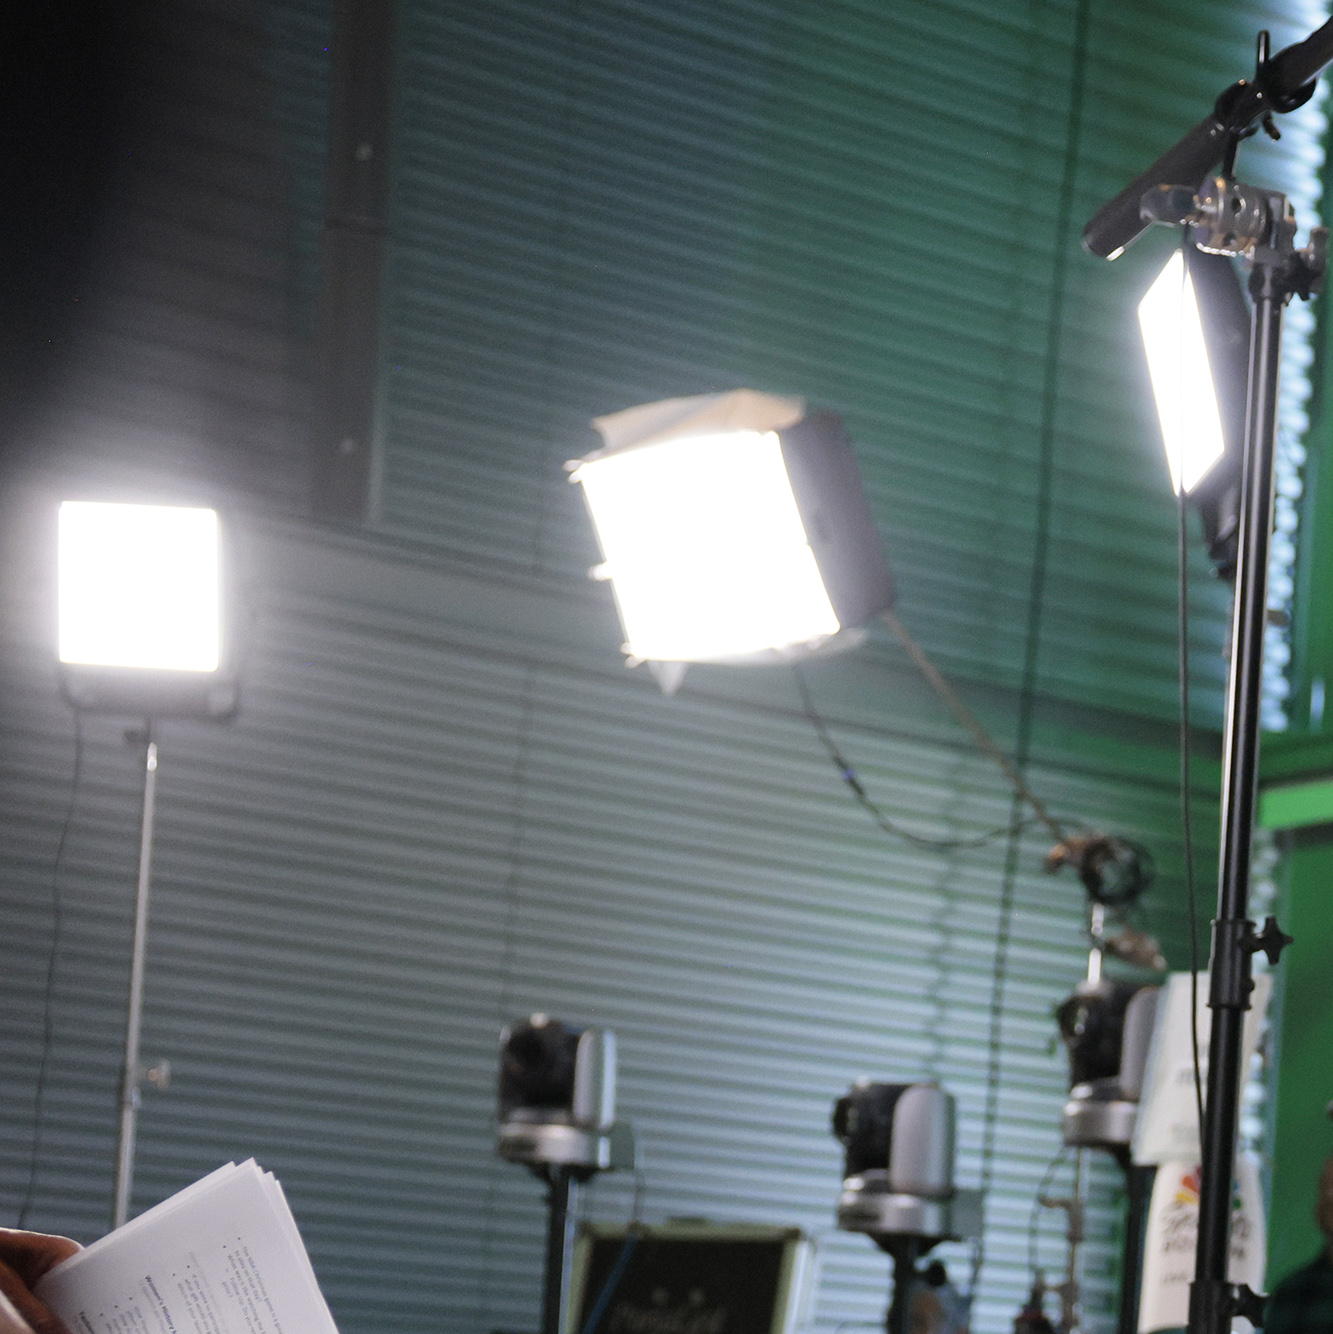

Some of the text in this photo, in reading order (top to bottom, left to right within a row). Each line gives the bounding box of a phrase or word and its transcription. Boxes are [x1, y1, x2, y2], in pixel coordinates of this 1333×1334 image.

[227, 1252, 238, 1270] What
[234, 1269, 242, 1281] was
[236, 1256, 246, 1269] play
[246, 1276, 256, 1289] that
[251, 1288, 261, 1303] day?
[242, 1245, 251, 1257] The
[247, 1255, 256, 1268] NBA
[252, 1268, 268, 1297] Christmas
[263, 1296, 274, 1313] game
[241, 1284, 250, 1296] like
[144, 1273, 166, 1306] Women's
[160, 1304, 176, 1331] History
[189, 1291, 198, 1303] gift
[195, 1301, 206, 1320] would
[201, 1319, 210, 1331] you
[245, 1295, 260, 1322] watching
[244, 1314, 253, 1327] you
[256, 1320, 264, 1331] the
